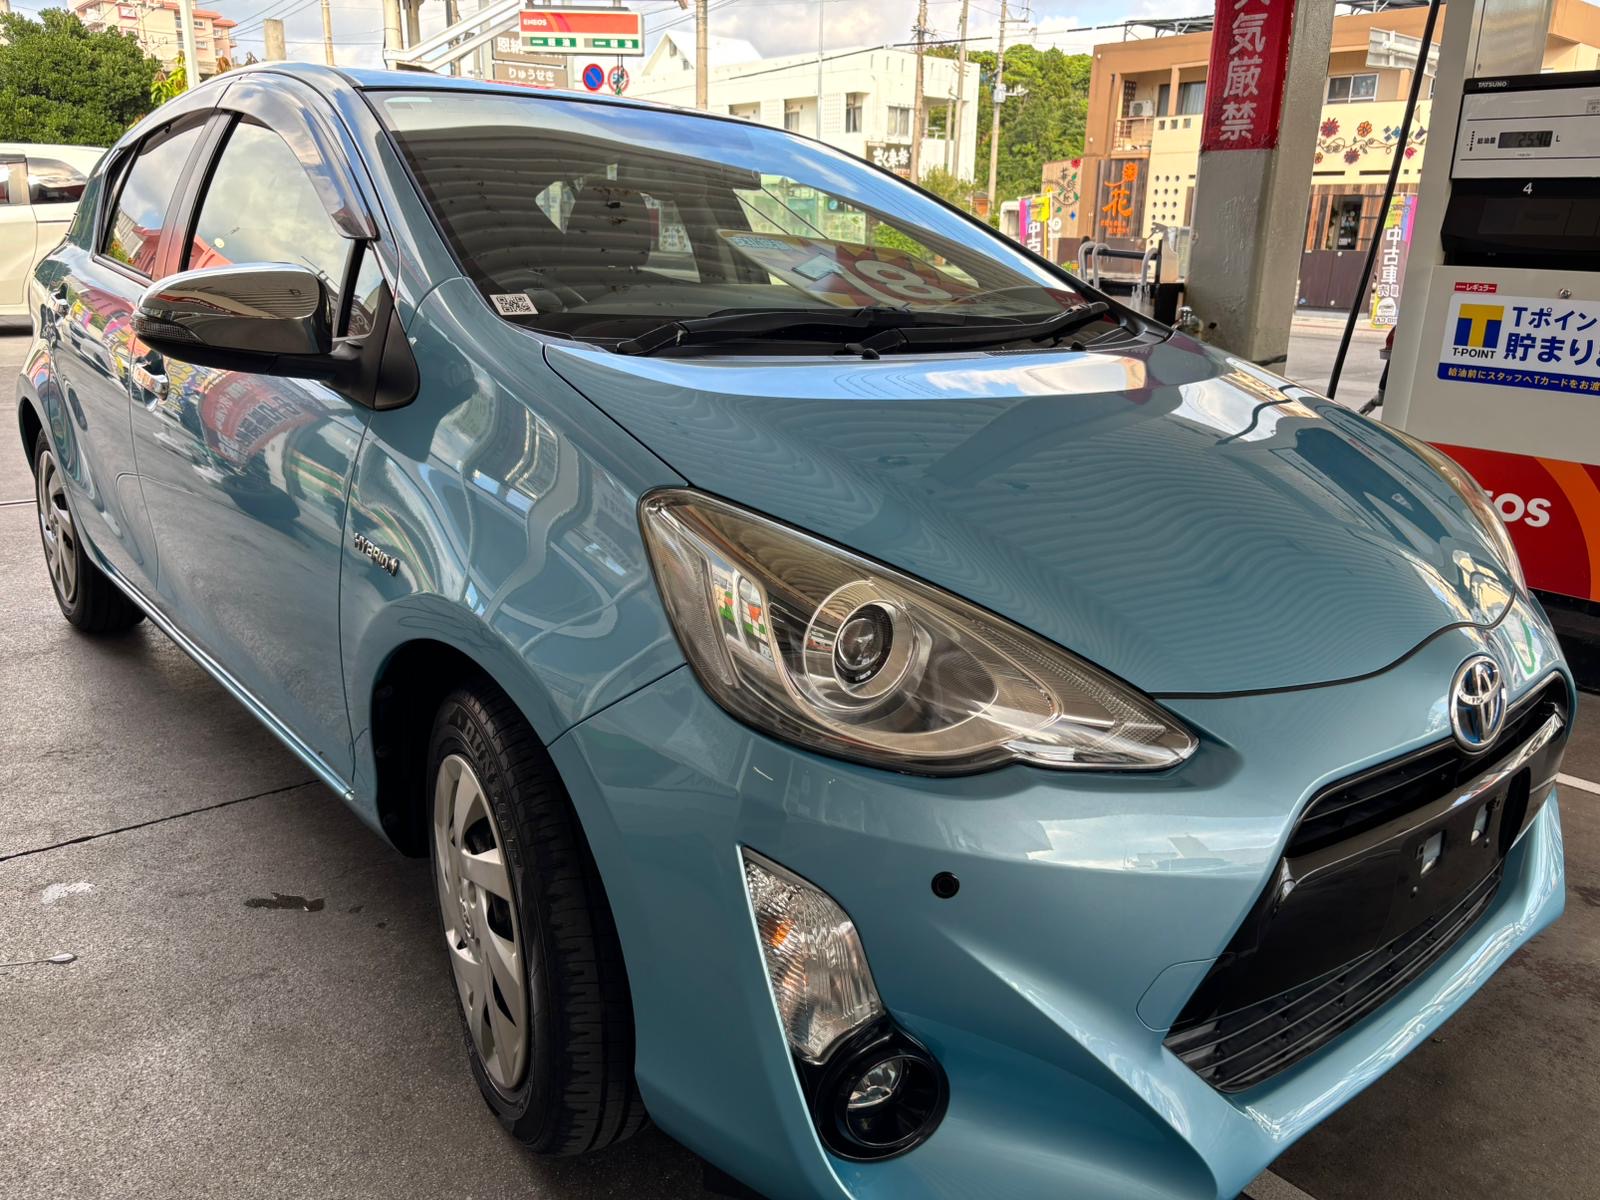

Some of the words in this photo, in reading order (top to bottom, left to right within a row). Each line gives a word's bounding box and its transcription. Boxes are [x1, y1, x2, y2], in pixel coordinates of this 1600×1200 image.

[508, 67, 555, 82] りゅうせき
[1220, 0, 1270, 141] 気厳禁
[1522, 182, 1533, 194] 4
[1380, 226, 1402, 285] 中古車
[1503, 332, 1600, 367] 貯まり
[1484, 489, 1552, 528] OS
